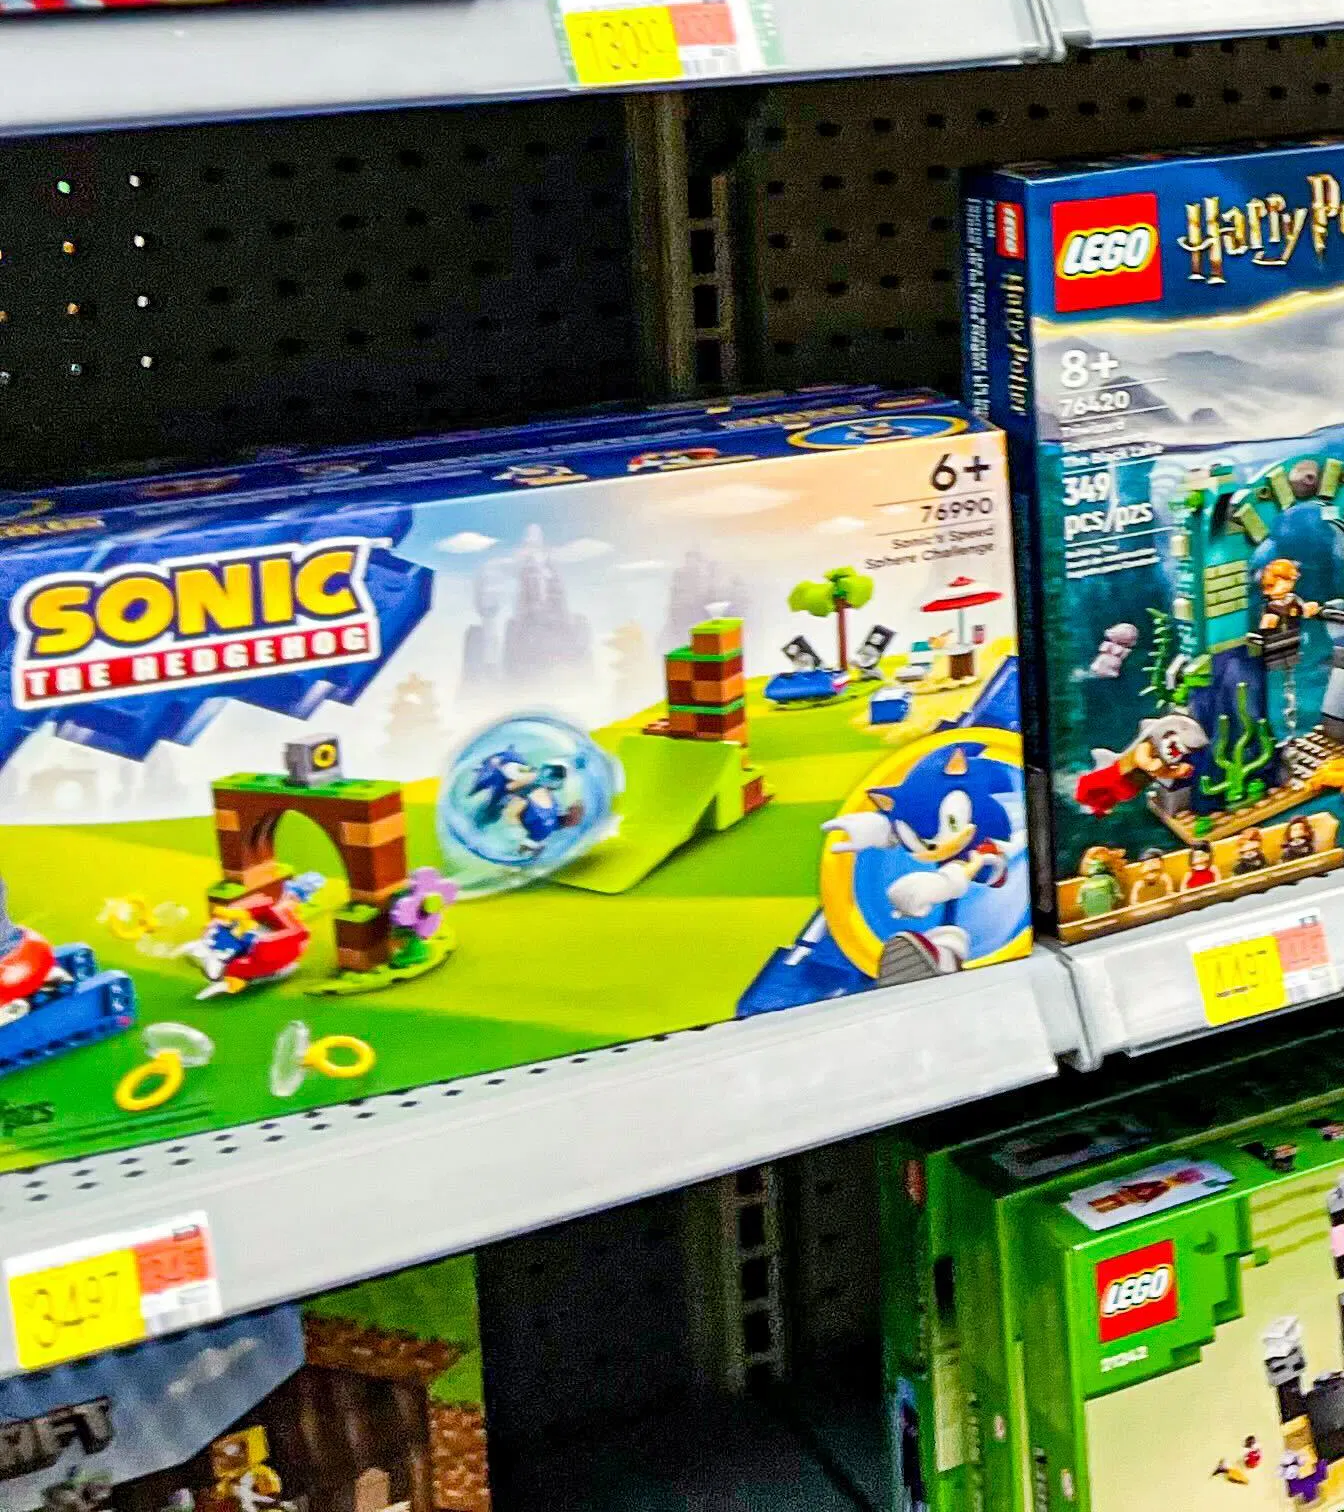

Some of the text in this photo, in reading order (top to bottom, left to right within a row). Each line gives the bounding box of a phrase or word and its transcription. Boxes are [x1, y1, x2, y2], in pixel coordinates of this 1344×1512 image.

[1064, 229, 1151, 274] LEGO
[1177, 194, 1307, 284] Harry
[1061, 350, 1118, 387] 8+
[1059, 390, 1130, 418] 76420
[931, 454, 991, 491] 6+
[1062, 473, 1112, 507] 349
[920, 497, 993, 523] 76990
[1064, 499, 1153, 540] pcs/pzs
[29, 550, 359, 656] SONIC
[26, 626, 368, 696] THE HEDGEHOG
[1103, 1267, 1169, 1314] LEGO
